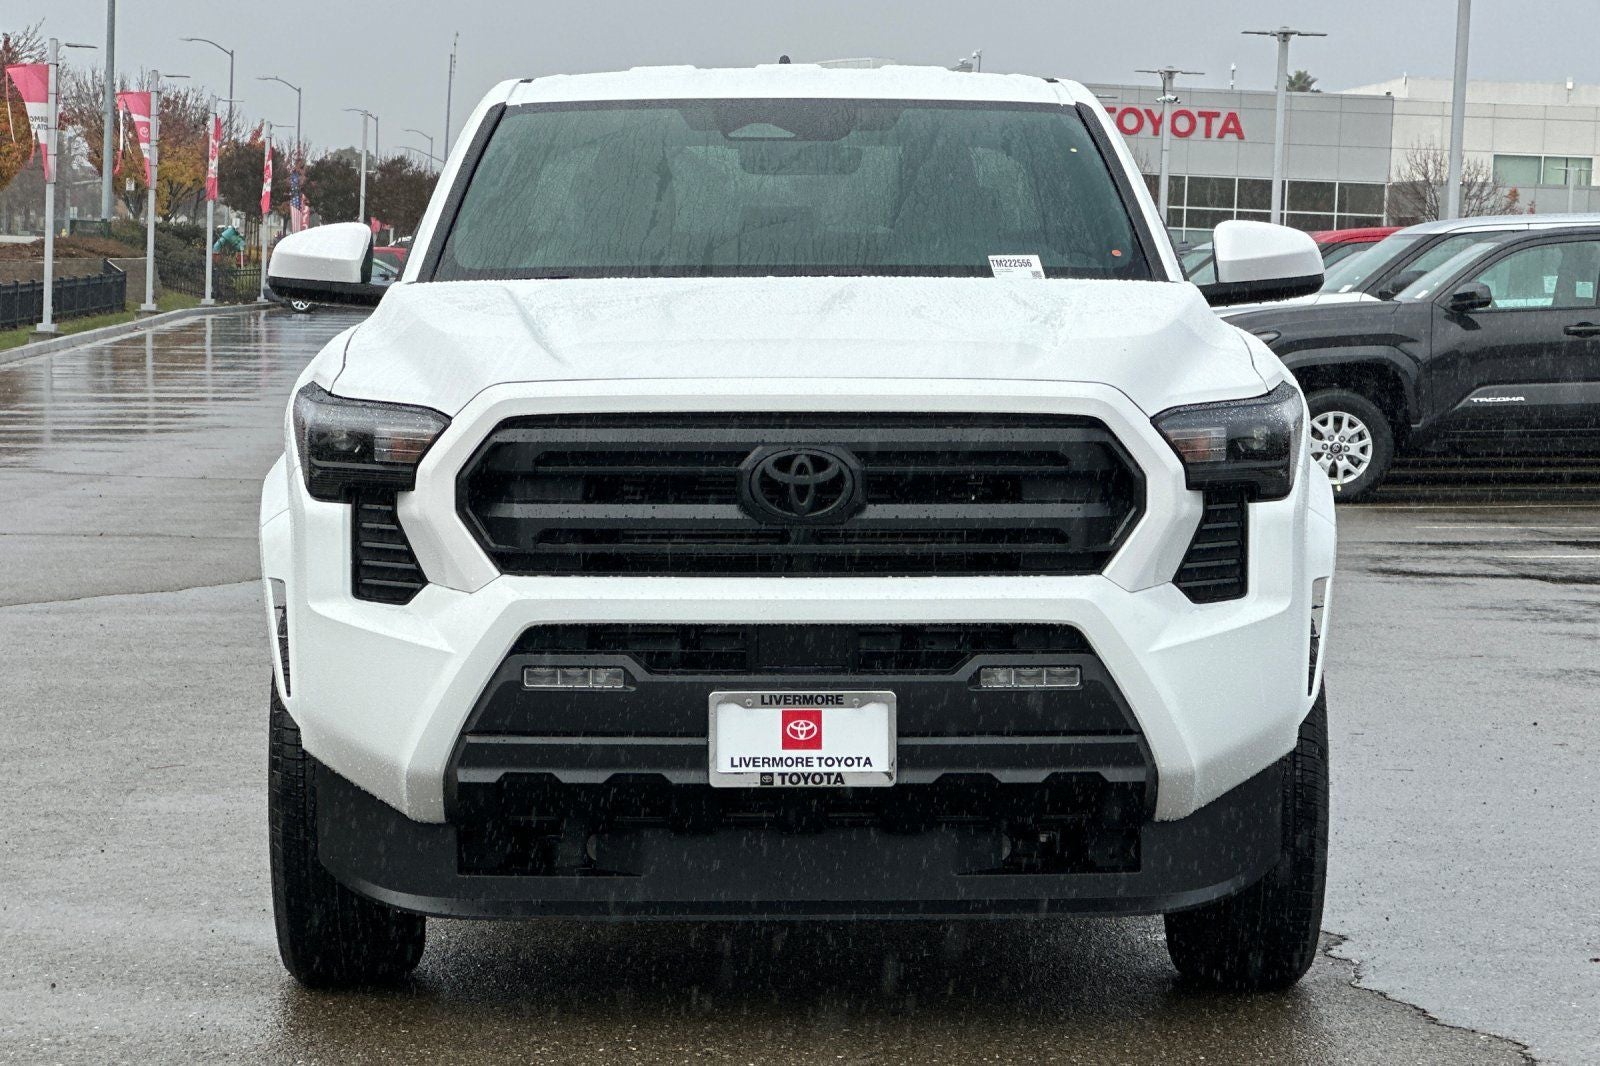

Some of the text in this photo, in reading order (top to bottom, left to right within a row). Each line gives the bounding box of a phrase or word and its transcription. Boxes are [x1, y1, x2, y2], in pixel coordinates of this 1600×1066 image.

[990, 259, 1033, 268] TM222556
[760, 694, 844, 706] LIVERMORE
[730, 756, 873, 769] LIVERMORE TOYOTA
[777, 772, 846, 786] TOYOTA
